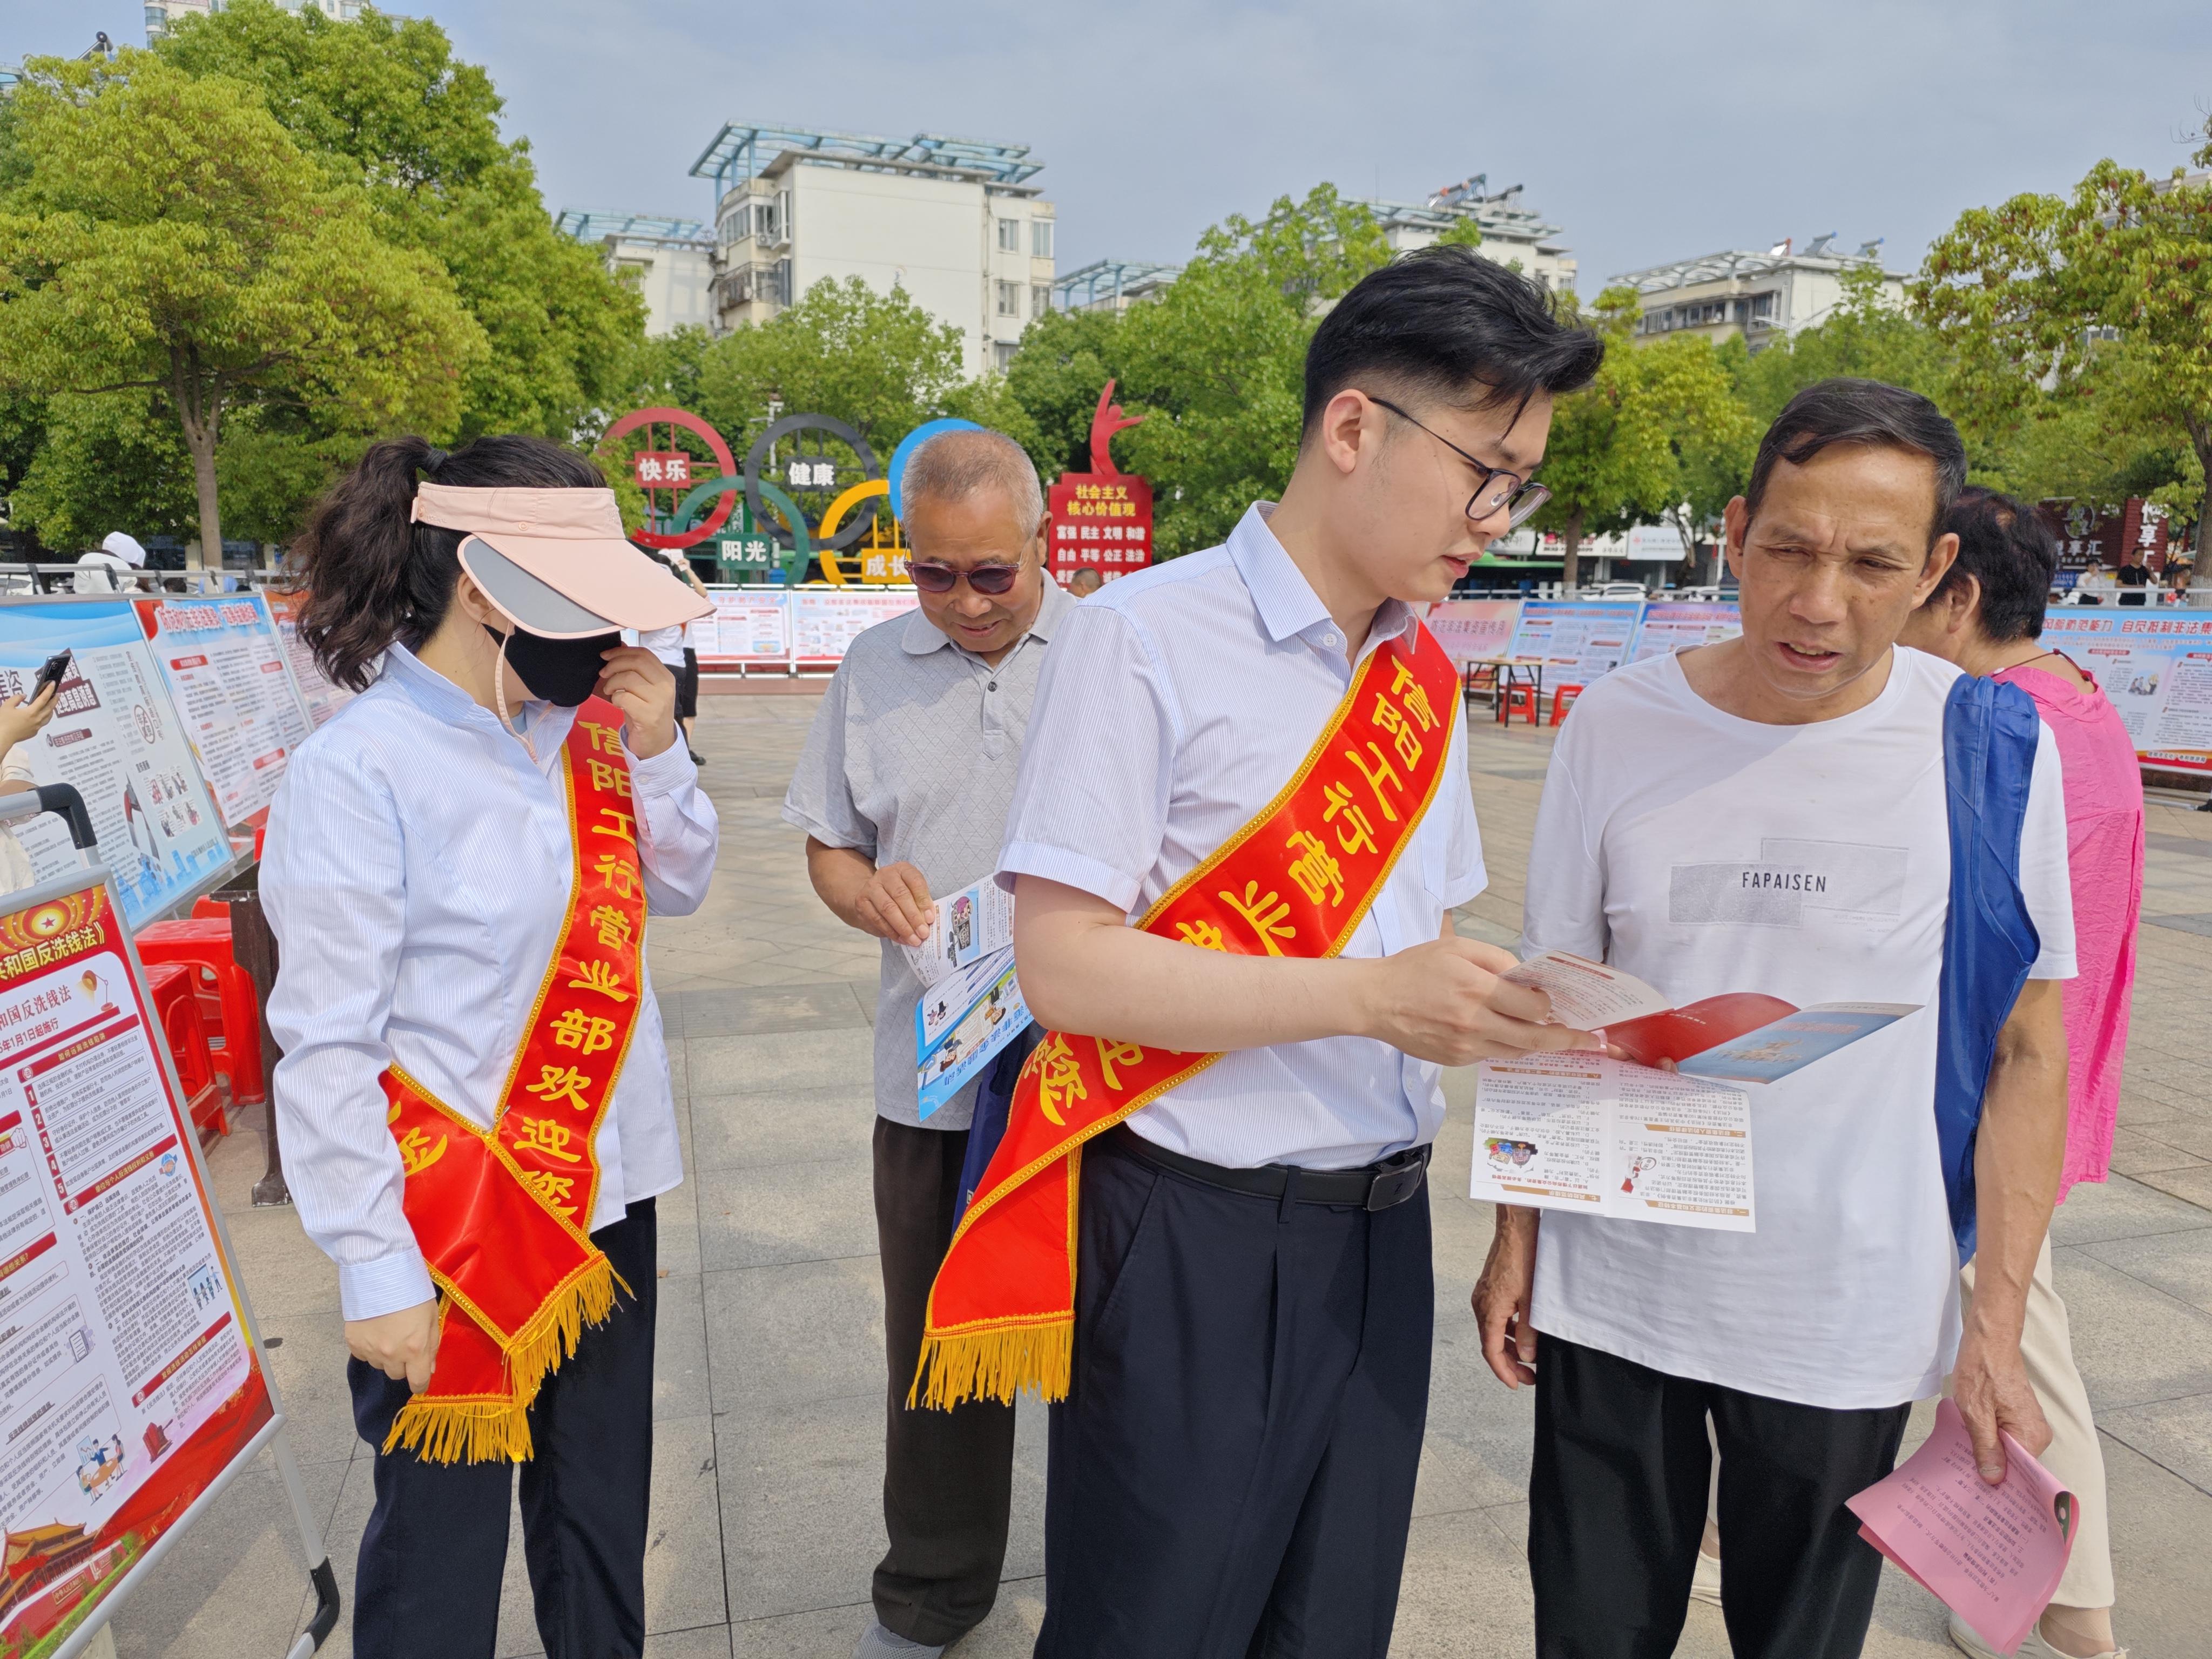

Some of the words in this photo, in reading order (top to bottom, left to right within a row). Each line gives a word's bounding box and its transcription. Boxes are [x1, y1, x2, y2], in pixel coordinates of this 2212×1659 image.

[639, 457, 687, 482] 快乐
[788, 461, 836, 487] 健康
[1075, 483, 1128, 500] 社会主义
[1067, 501, 1136, 517] 核心价值观
[1056, 525, 1077, 539] 富强
[1081, 525, 1100, 539] 民主
[1103, 525, 1123, 540] 文明
[1125, 526, 1145, 541] 和谐
[721, 540, 767, 562] 阳光
[1057, 548, 1077, 562] 自由
[1081, 548, 1101, 562] 平等
[1103, 548, 1123, 562] 公正
[1125, 548, 1145, 563] 法治
[865, 557, 906, 577] 成长
[46, 733, 53, 747] 3
[1742, 871, 1826, 892] FAPAISEN
[58, 1031, 106, 1061] 如何远离洗钱陷阱
[27, 1089, 35, 1102] 1
[33, 1112, 43, 1126] 2
[41, 1136, 50, 1149] 3
[49, 1158, 58, 1172] 4
[95, 1150, 154, 1193] 单位与个人反洗钱权利和义务
[56, 1181, 65, 1195] 5
[1548, 1190, 1597, 1200] 七、风险防范提示
